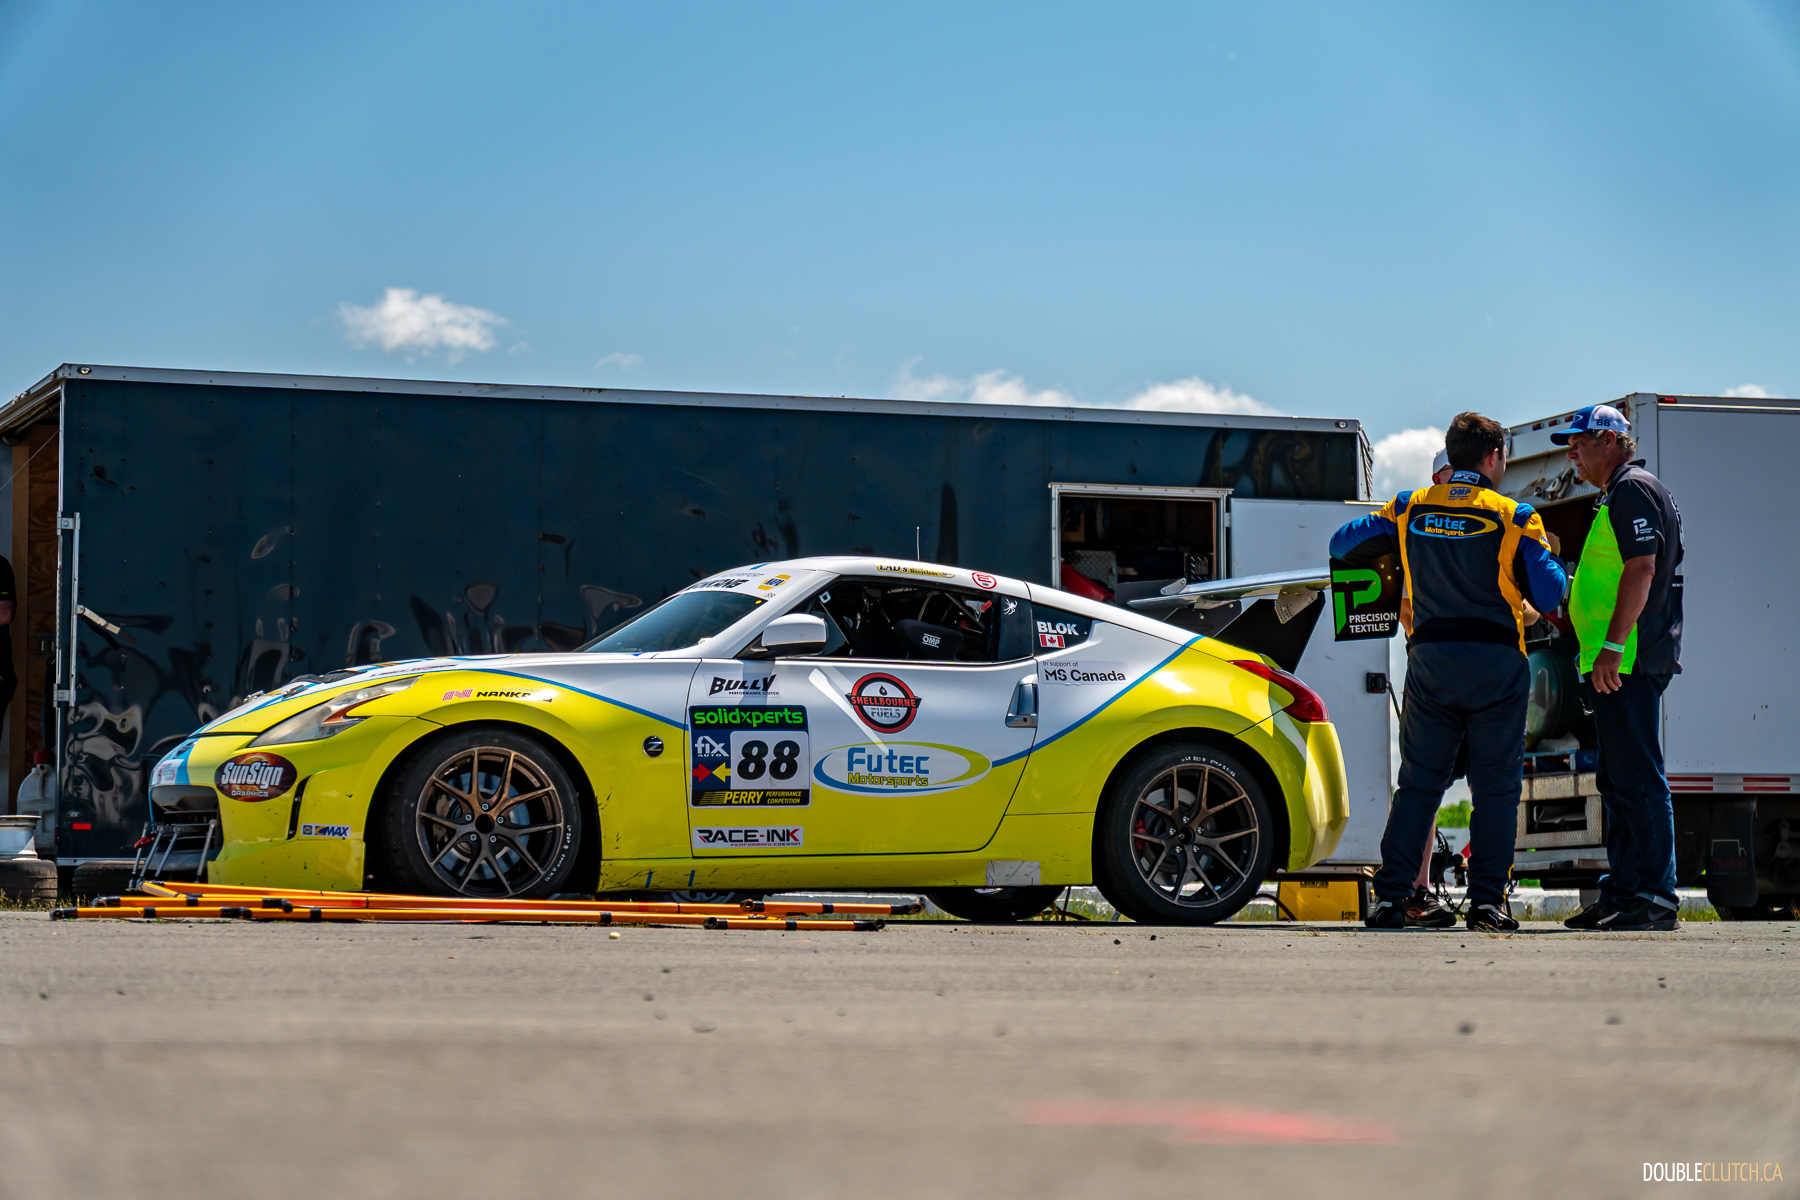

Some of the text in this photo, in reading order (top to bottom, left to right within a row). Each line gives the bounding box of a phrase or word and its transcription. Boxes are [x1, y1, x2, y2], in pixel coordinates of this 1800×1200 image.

[1424, 514, 1466, 530] Futec
[1424, 527, 1465, 536] Motorsports
[1349, 612, 1398, 624] PRECISION
[1037, 621, 1079, 636] BLOK
[1349, 622, 1390, 634] TEXTILES
[922, 635, 940, 646] OMP
[1044, 669, 1126, 681] MS Canada
[709, 674, 777, 696] BULLY
[851, 697, 917, 708] SHELLBOURNE
[694, 708, 804, 728] solidxperts
[871, 707, 901, 718] FUELS
[695, 736, 729, 757] fix
[737, 740, 801, 781] 88
[847, 747, 930, 775] Futec
[221, 762, 284, 790] SunSign
[847, 772, 929, 788] Motorsports
[231, 790, 269, 798] GRAPHICS
[723, 791, 764, 804] PERRY
[697, 828, 800, 843] RACE-INK
